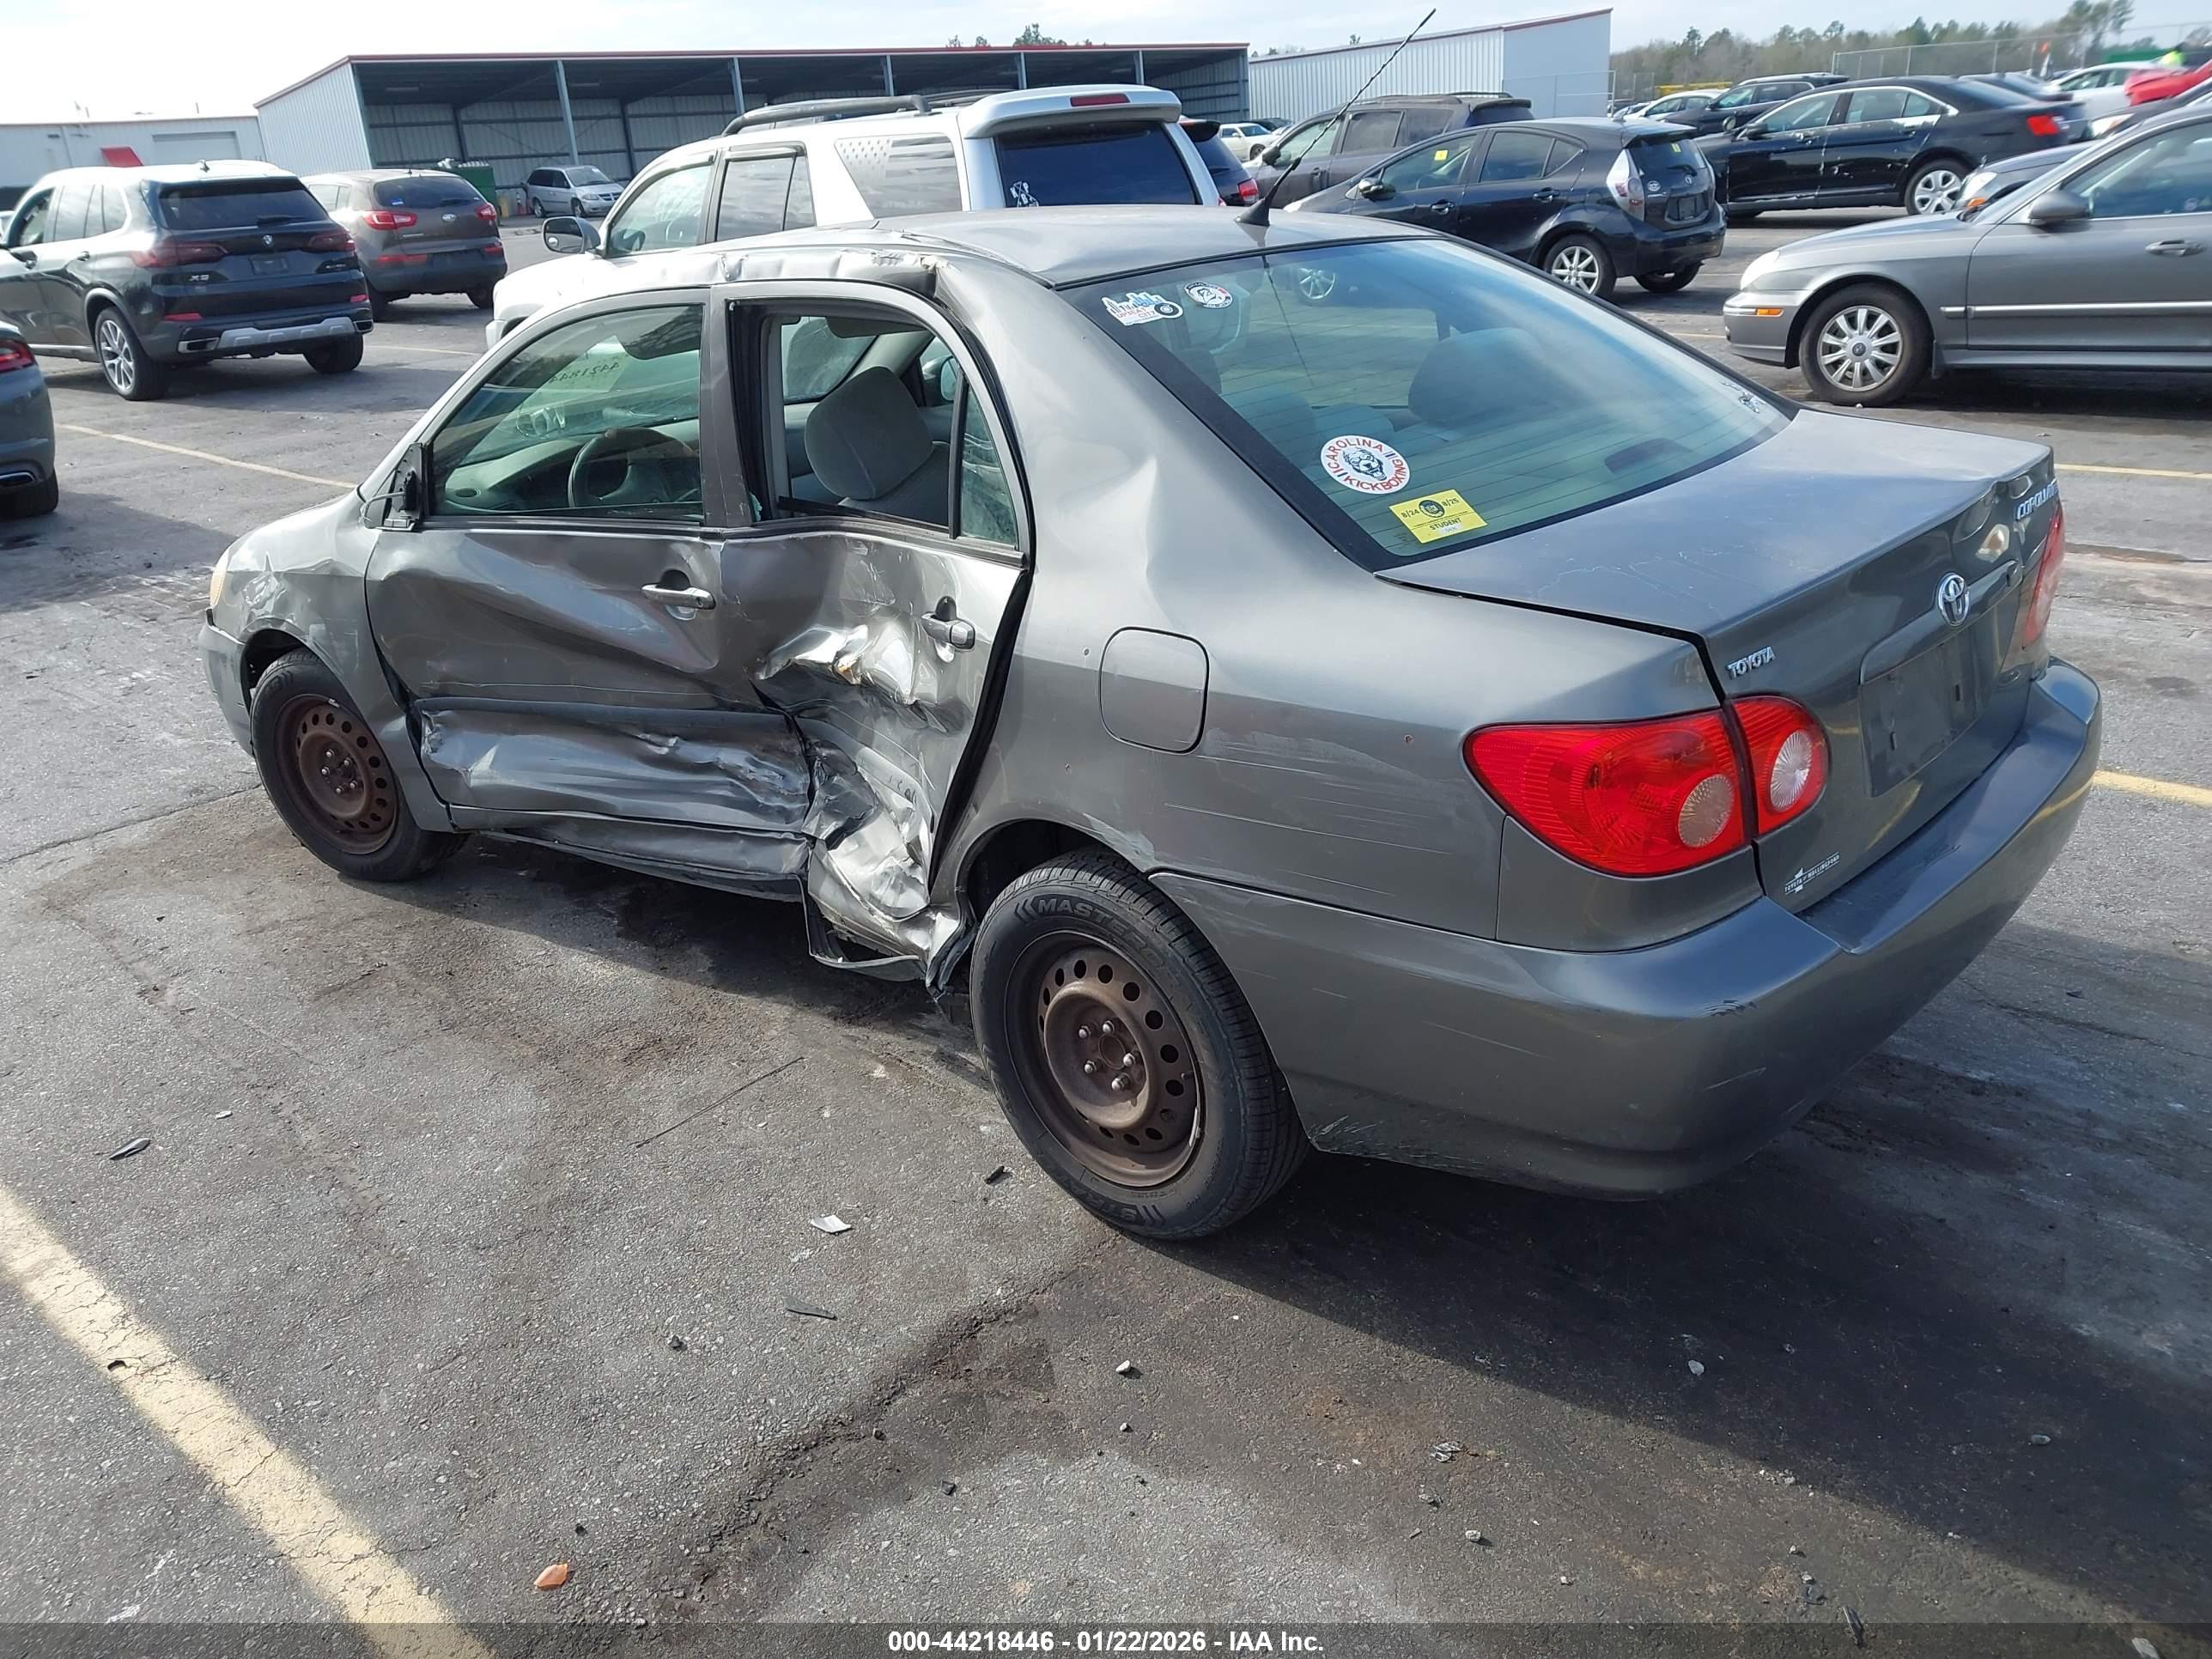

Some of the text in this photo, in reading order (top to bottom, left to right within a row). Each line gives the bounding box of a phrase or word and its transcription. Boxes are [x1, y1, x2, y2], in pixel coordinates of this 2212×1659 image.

[1325, 437, 1384, 470] CAROLINA
[1343, 458, 1405, 492] KICKBOXING
[1401, 508, 1420, 519] 8/24
[1441, 497, 1461, 507] 8/25
[1429, 517, 1462, 531] STUDENT
[1727, 646, 1776, 679] TOYOTA
[1784, 878, 1802, 893] TOYOTA
